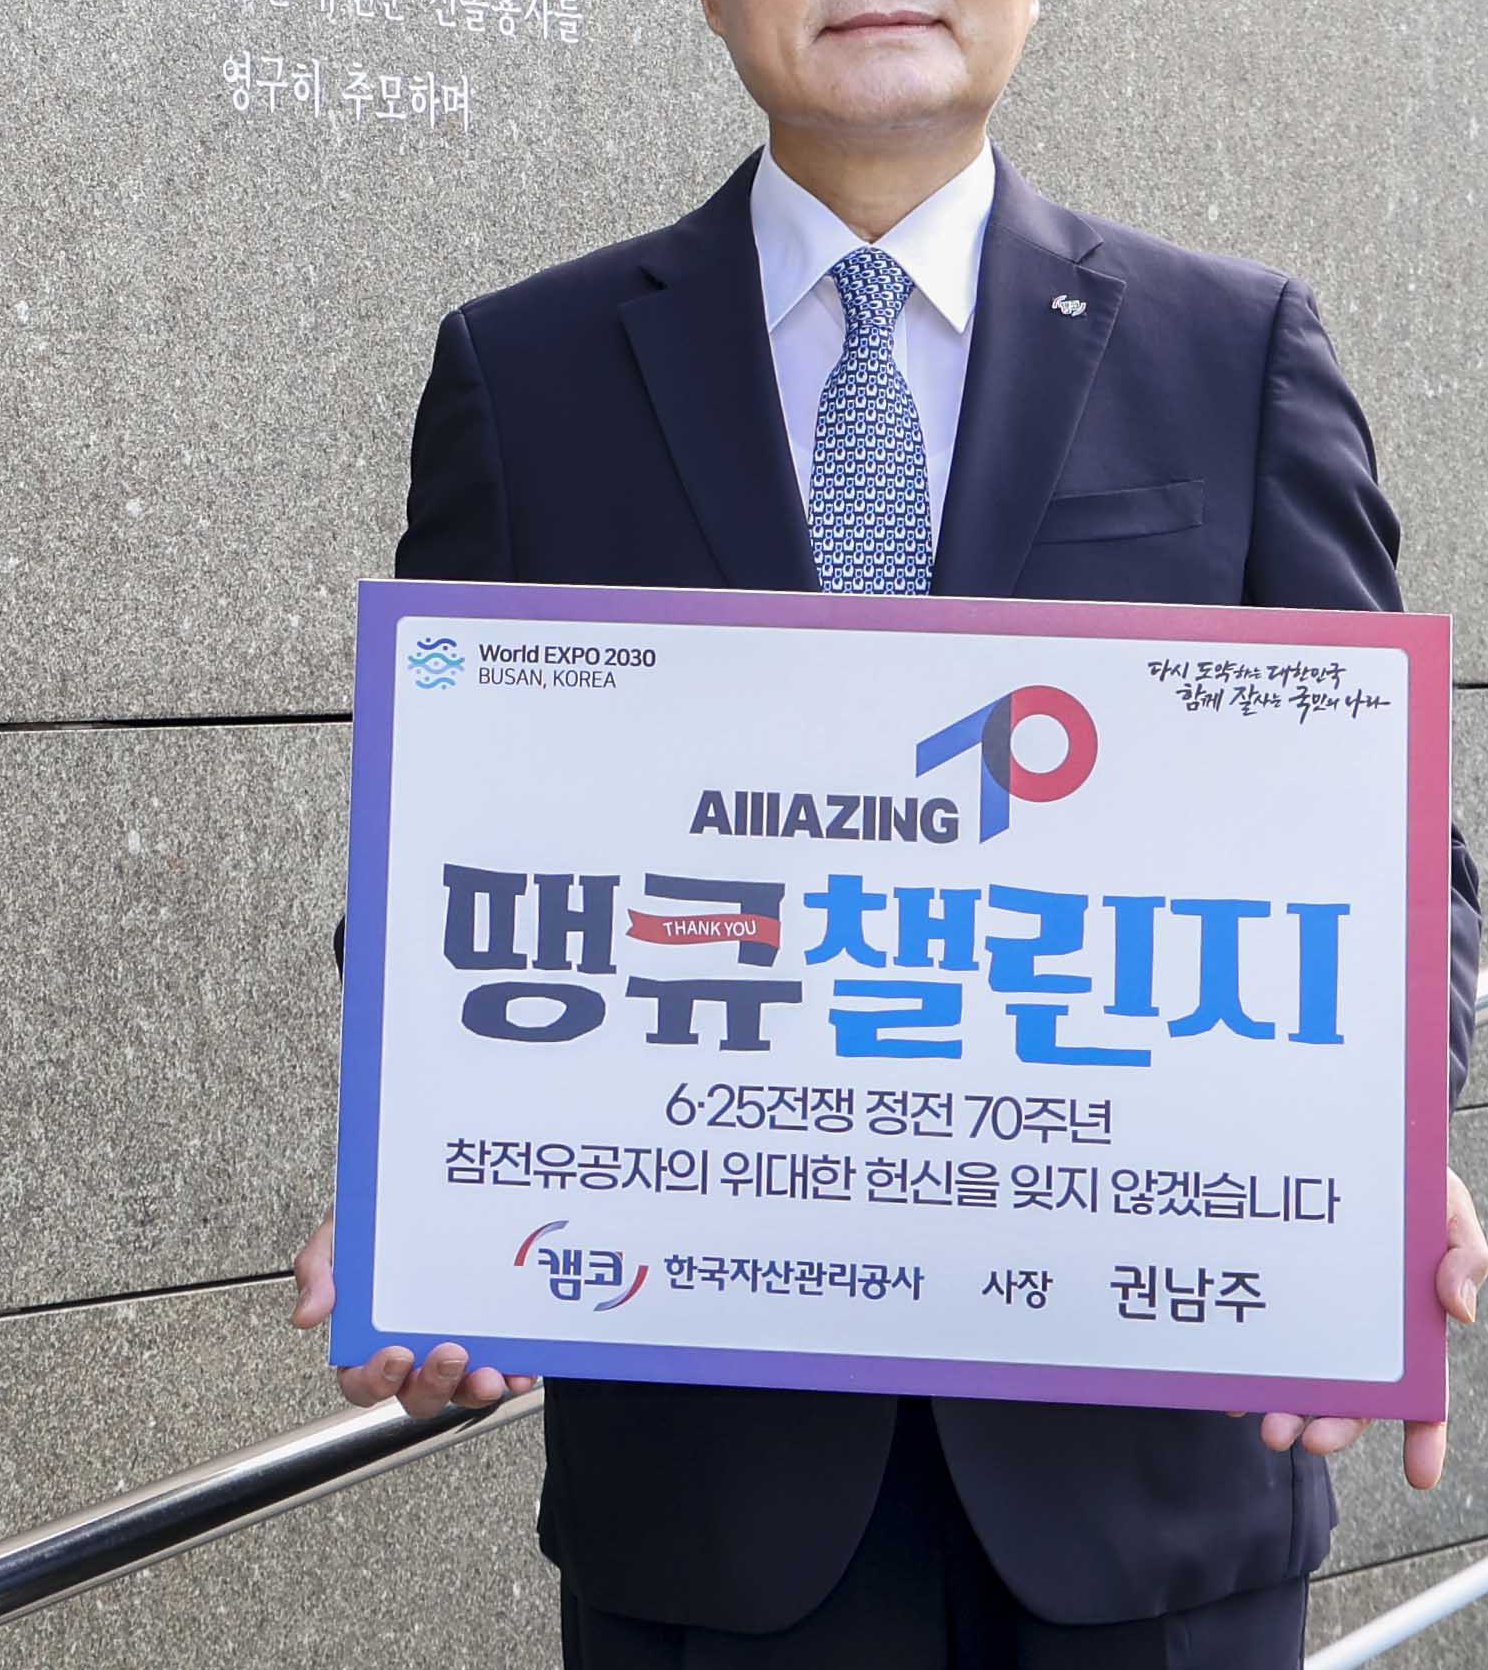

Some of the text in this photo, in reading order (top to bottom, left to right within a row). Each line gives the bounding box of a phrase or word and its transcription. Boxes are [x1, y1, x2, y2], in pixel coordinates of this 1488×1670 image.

[222, 49, 470, 132] 영구히 추모하며
[479, 644, 656, 667] World EXPO 2030
[1147, 659, 1346, 690] 다시 도약하는 대한민국
[479, 667, 616, 688] BUSAN, KOREA
[1176, 683, 1224, 711] 함께
[1289, 685, 1338, 724] 국민의
[1345, 689, 1391, 718] 나라
[663, 920, 756, 936] THANK YOU
[865, 1088, 955, 1136] 정전
[965, 1093, 1113, 1148] 70주년
[445, 1136, 1341, 1226] 참전유공자의 위대한 헌신을 잊지 않겠습니다
[538, 1248, 1267, 1323] 캠코 한국자산관리공사 사장 권남주
